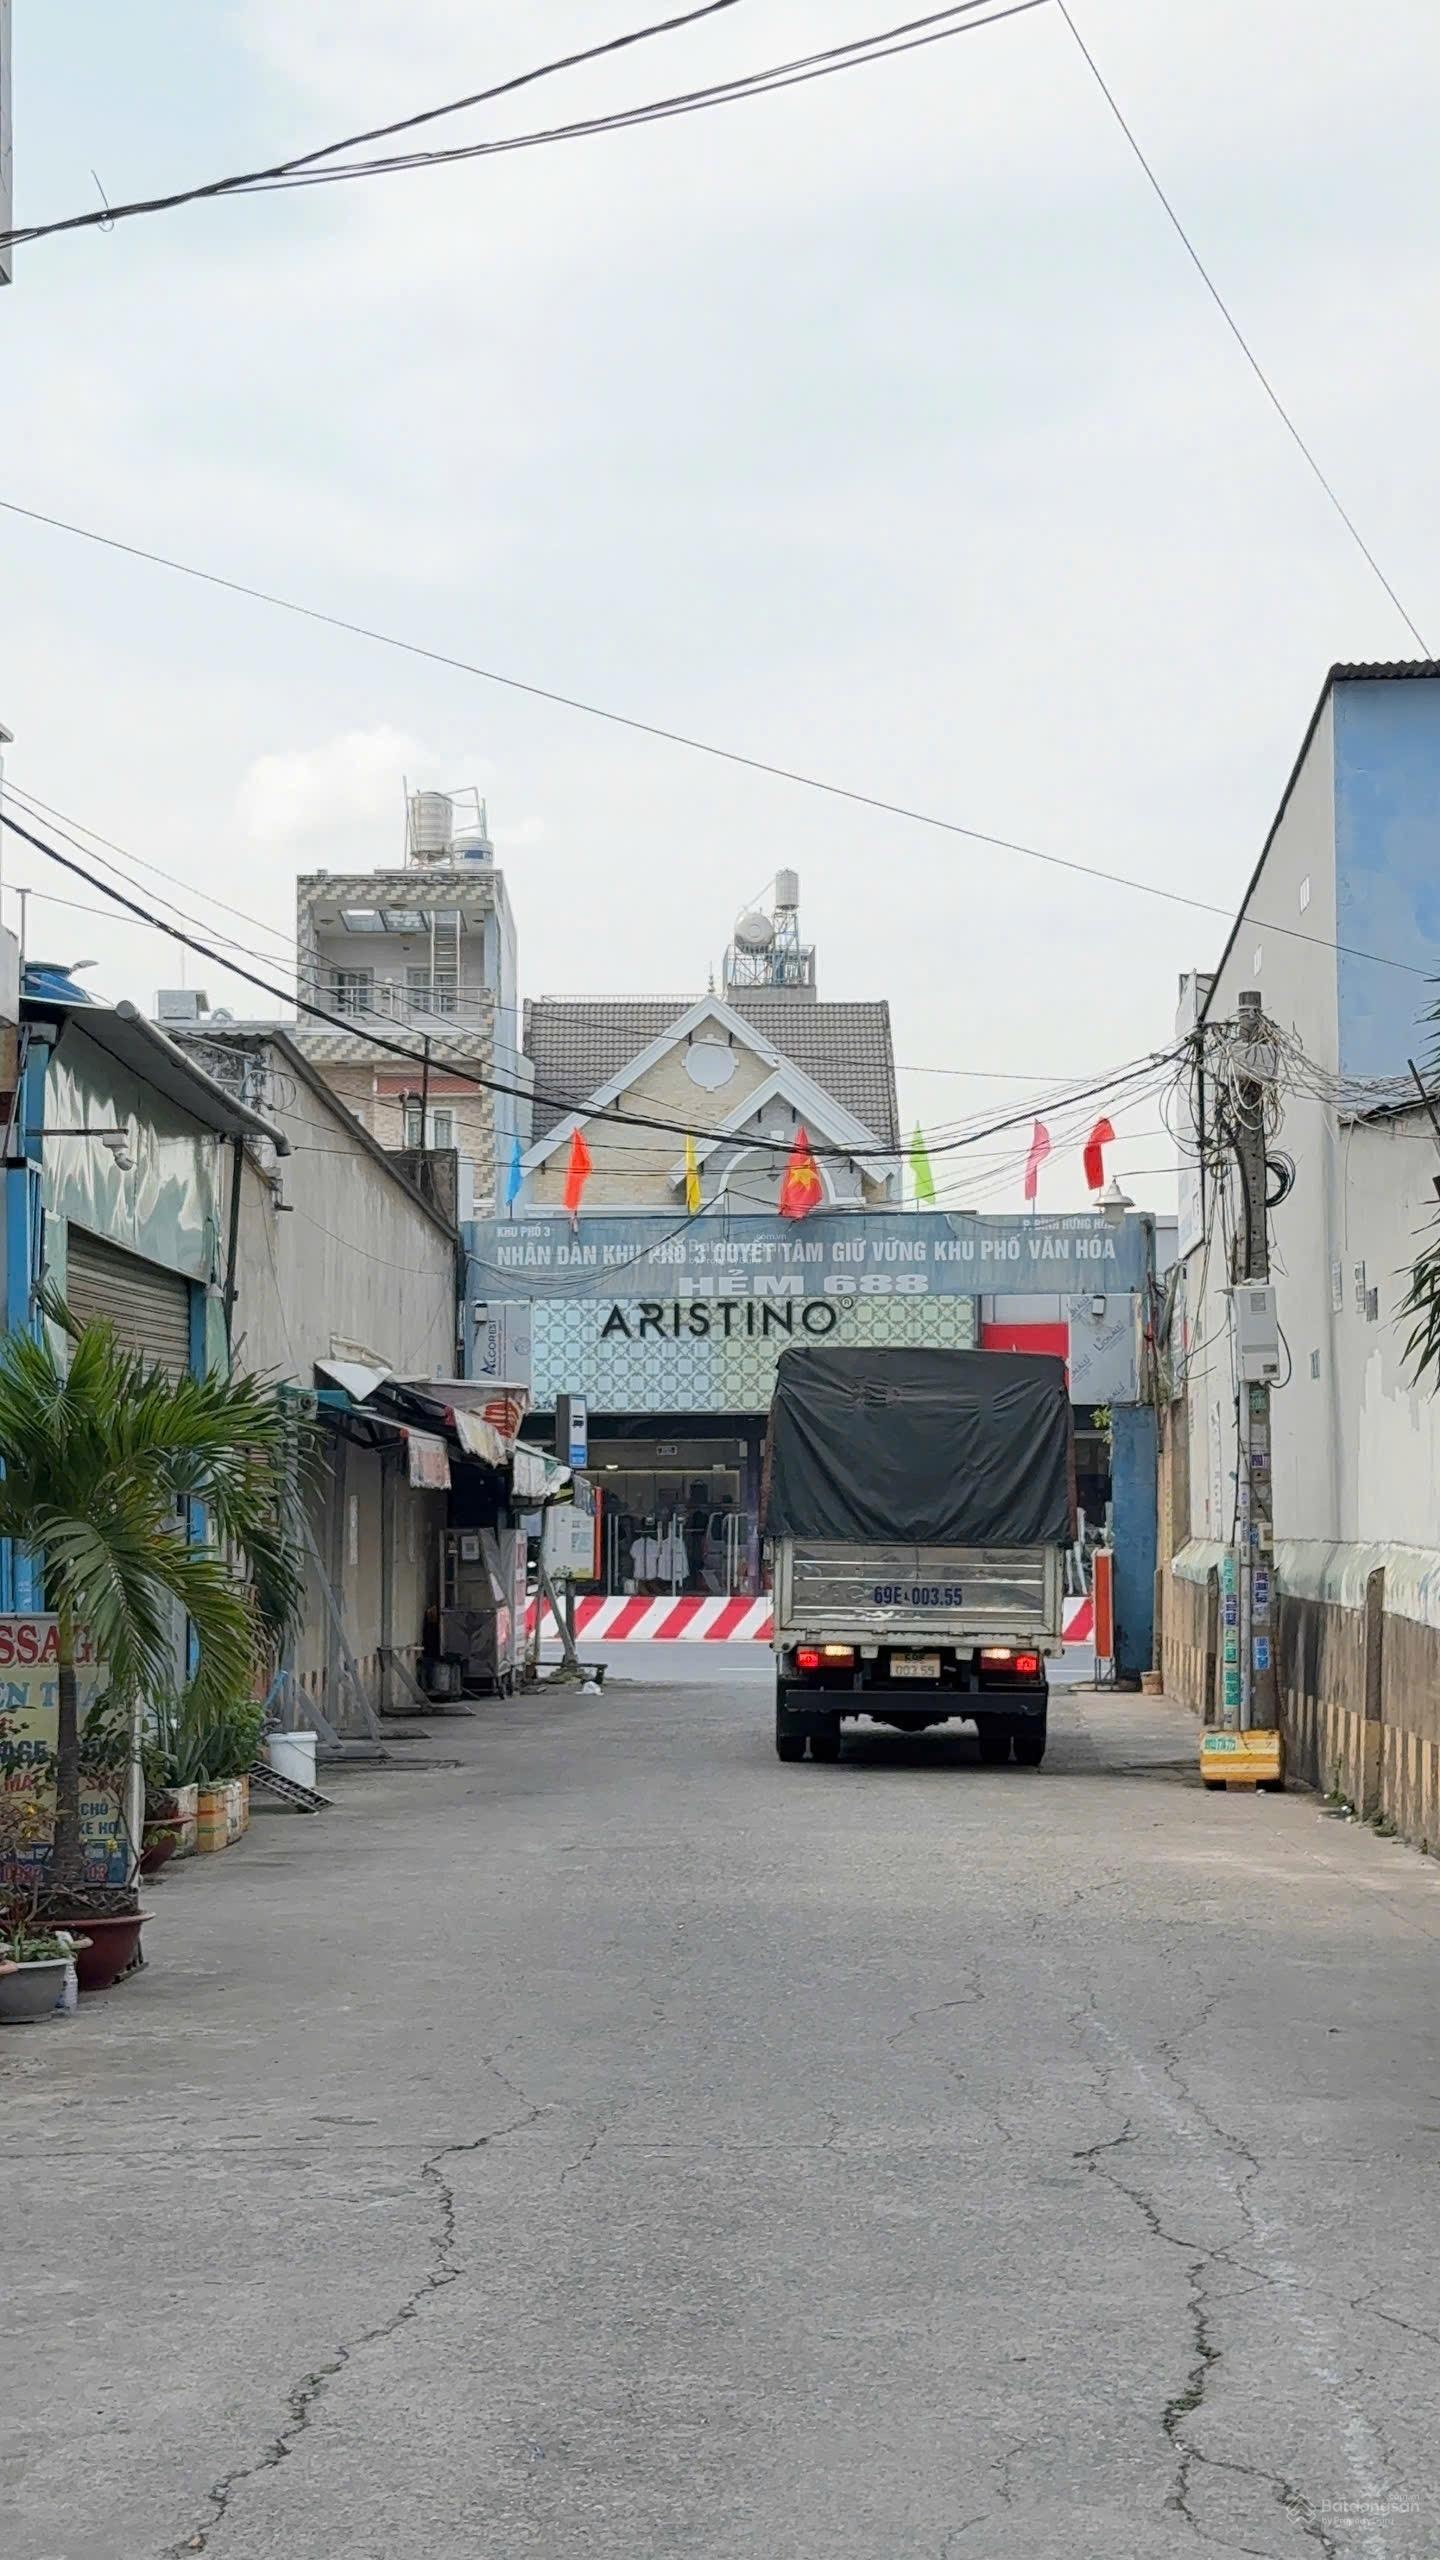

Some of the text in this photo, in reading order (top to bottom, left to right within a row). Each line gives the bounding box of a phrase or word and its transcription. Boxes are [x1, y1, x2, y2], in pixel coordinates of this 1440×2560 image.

[496, 1222, 551, 1237] KHU PHỐ 3
[497, 1241, 550, 1266] NHÂN
[557, 1240, 597, 1265] DÂN
[603, 1243, 642, 1265] KHU
[695, 1242, 706, 1264] 3
[780, 1239, 823, 1263] TÂM
[832, 1237, 866, 1262] GIỮ
[872, 1236, 926, 1262] VỮNG
[934, 1240, 975, 1261] KHU
[980, 1233, 1021, 1261] PHỐ
[1027, 1236, 1069, 1260] VĂN
[1075, 1234, 1116, 1260] HÓA
[679, 1269, 929, 1297] HẺM 688
[601, 1300, 837, 1338] ARISTINO
